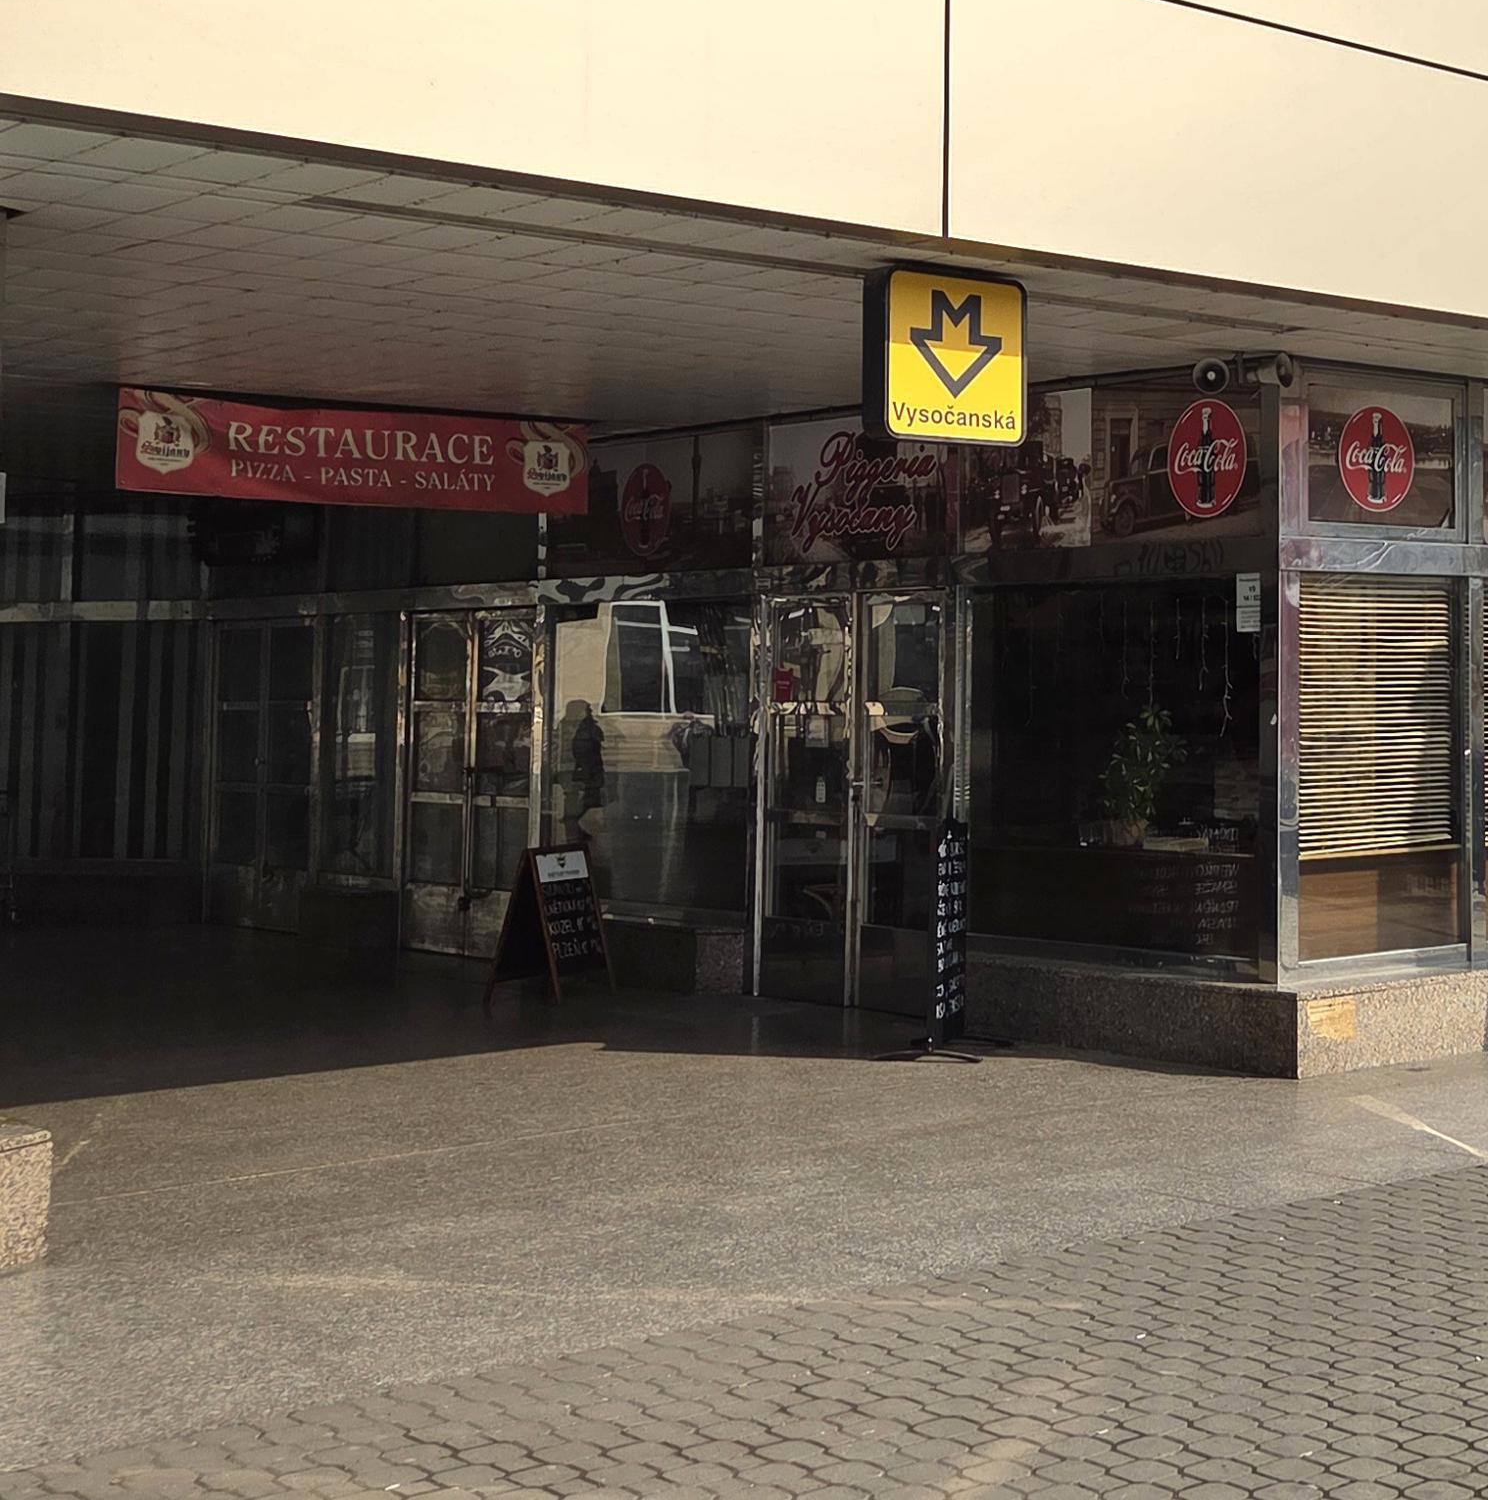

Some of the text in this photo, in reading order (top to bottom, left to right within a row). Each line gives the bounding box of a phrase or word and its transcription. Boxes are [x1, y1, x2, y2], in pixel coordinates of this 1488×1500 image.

[892, 400, 1016, 430] Vysočanská
[227, 420, 496, 466] RESTAURACE
[230, 459, 297, 482] PIZZA
[320, 467, 393, 488] PASTA
[414, 469, 496, 492] SALÁTY
[814, 431, 938, 507] Pizzeria
